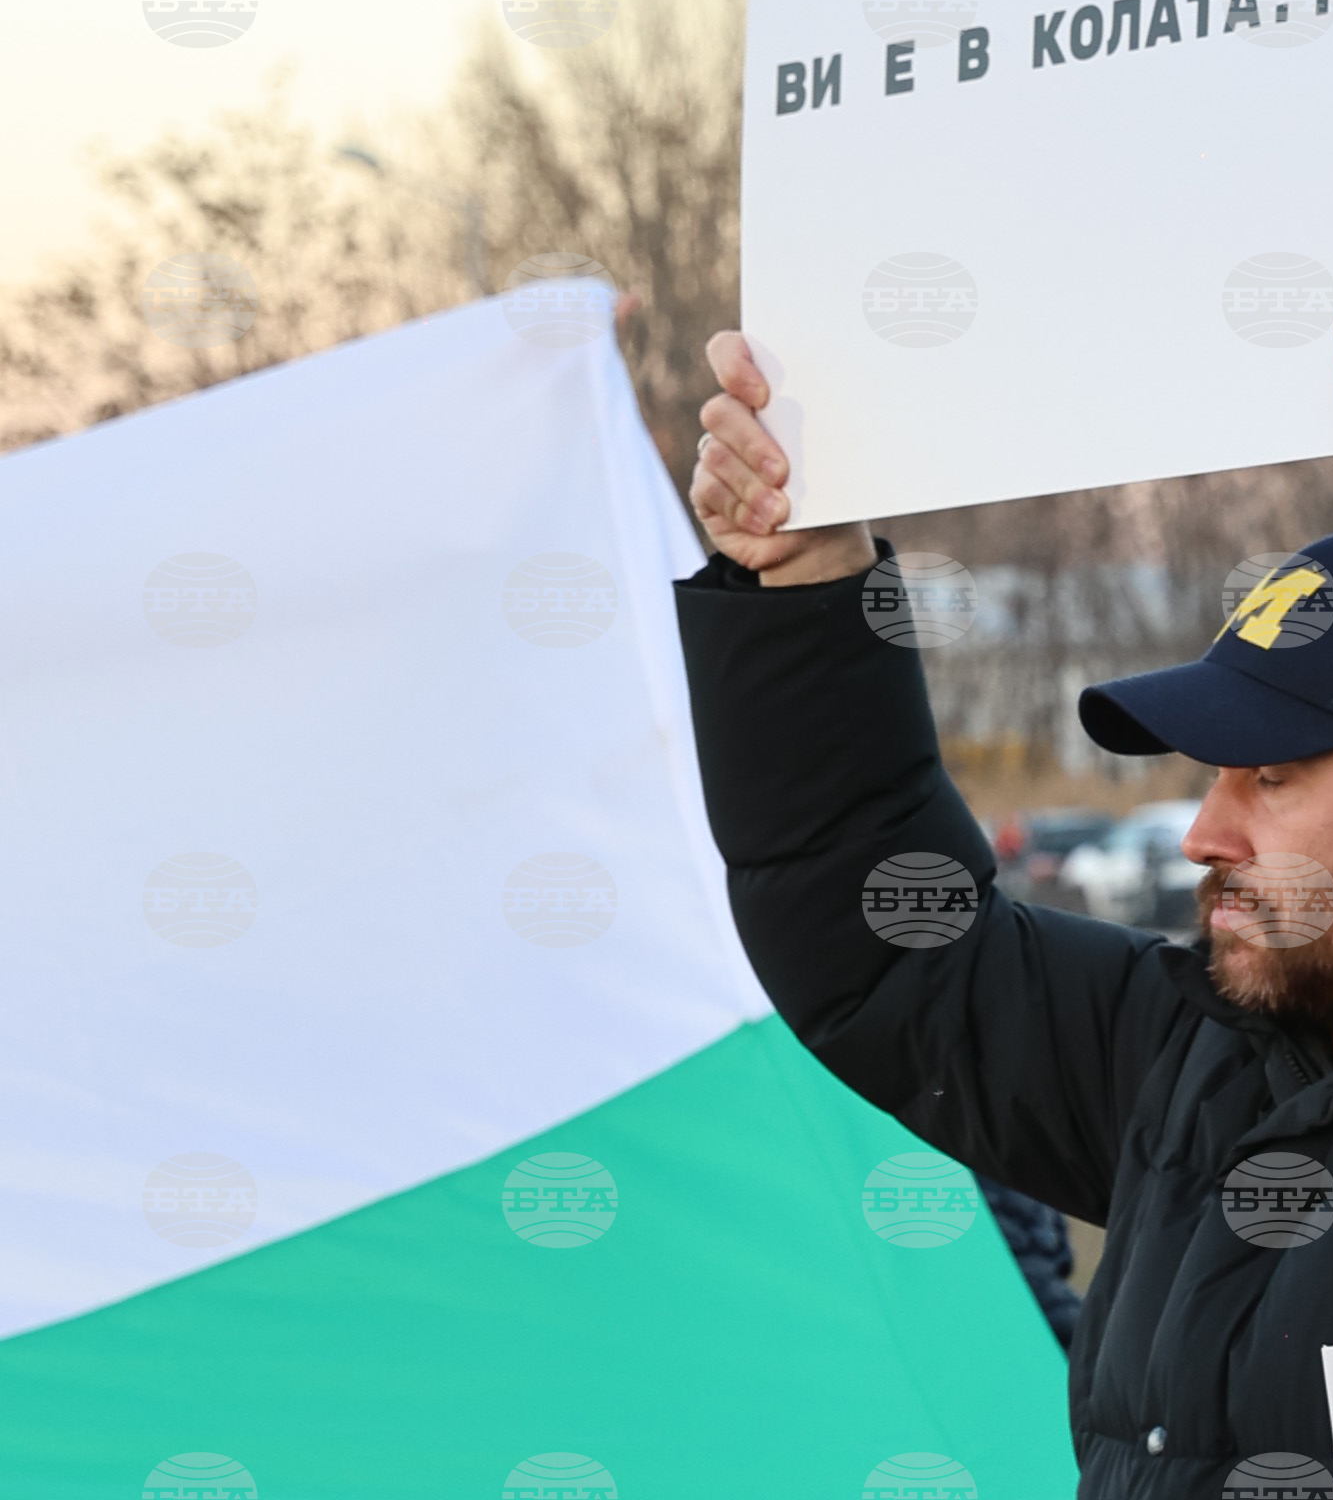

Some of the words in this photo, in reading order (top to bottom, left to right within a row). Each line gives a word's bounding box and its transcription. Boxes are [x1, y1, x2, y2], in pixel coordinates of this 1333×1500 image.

[776, 54, 842, 116] ВИ
[885, 40, 915, 96] Е
[958, 27, 989, 82] В
